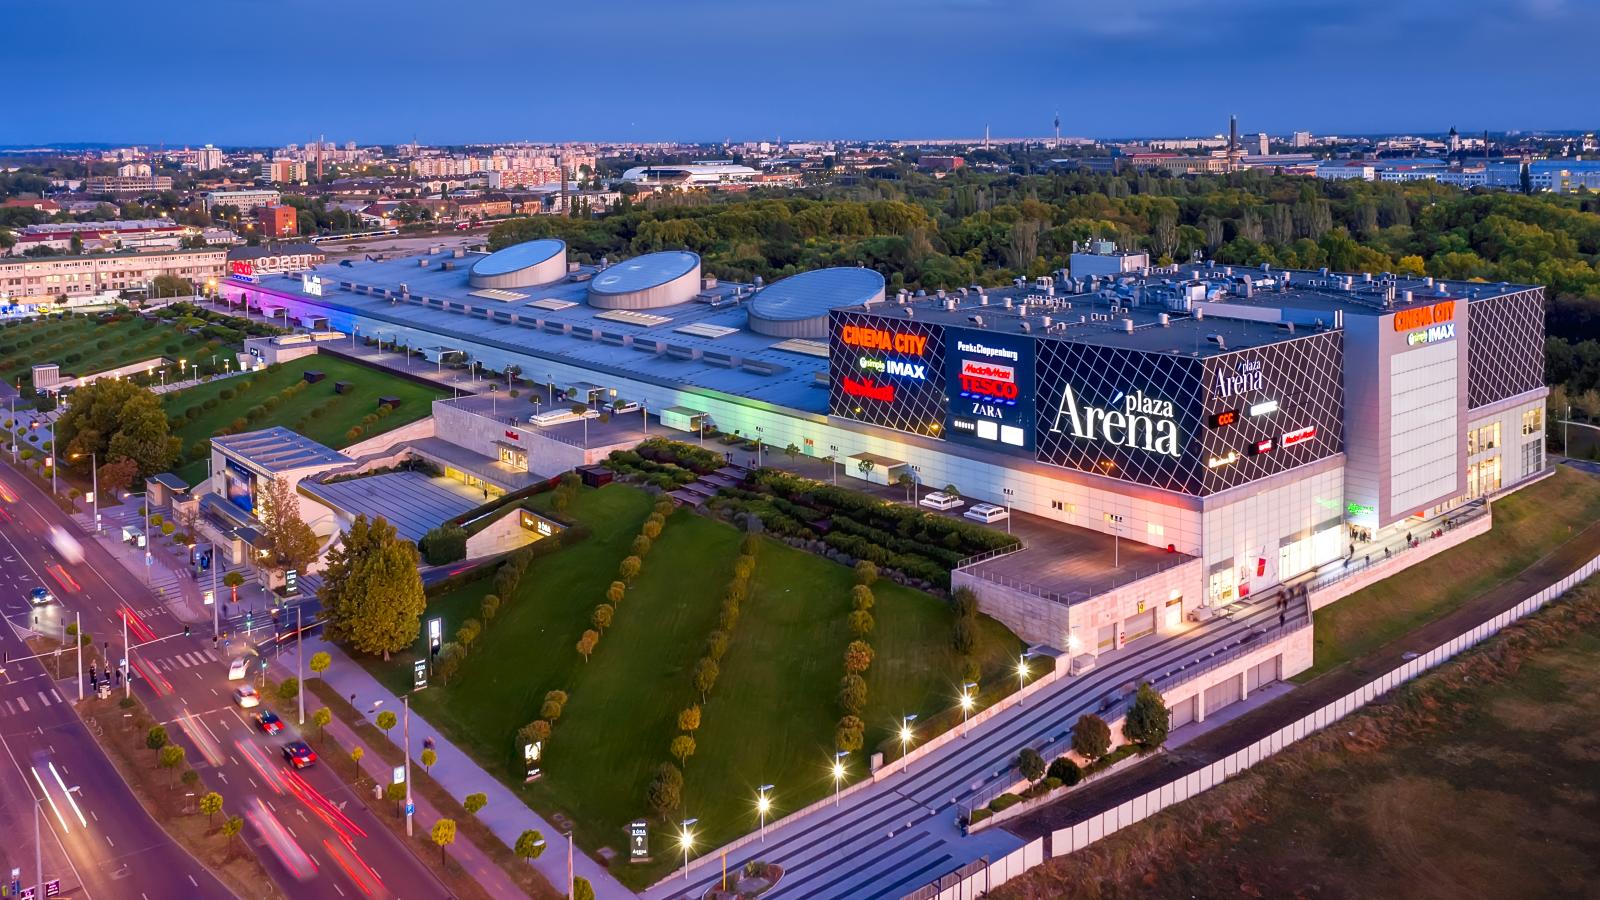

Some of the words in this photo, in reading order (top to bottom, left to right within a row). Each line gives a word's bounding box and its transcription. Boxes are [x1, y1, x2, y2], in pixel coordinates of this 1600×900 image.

[1394, 306, 1433, 332] CINEMA
[1433, 300, 1456, 323] CITY
[843, 325, 892, 350] CINEMA
[894, 333, 927, 356] CITY
[1428, 323, 1455, 343] IMAX
[887, 360, 925, 379] IMAX
[959, 373, 1018, 399] TESCO
[972, 402, 1003, 419] ZARA
[1125, 390, 1173, 418] plaza
[1218, 412, 1234, 425] CCC
